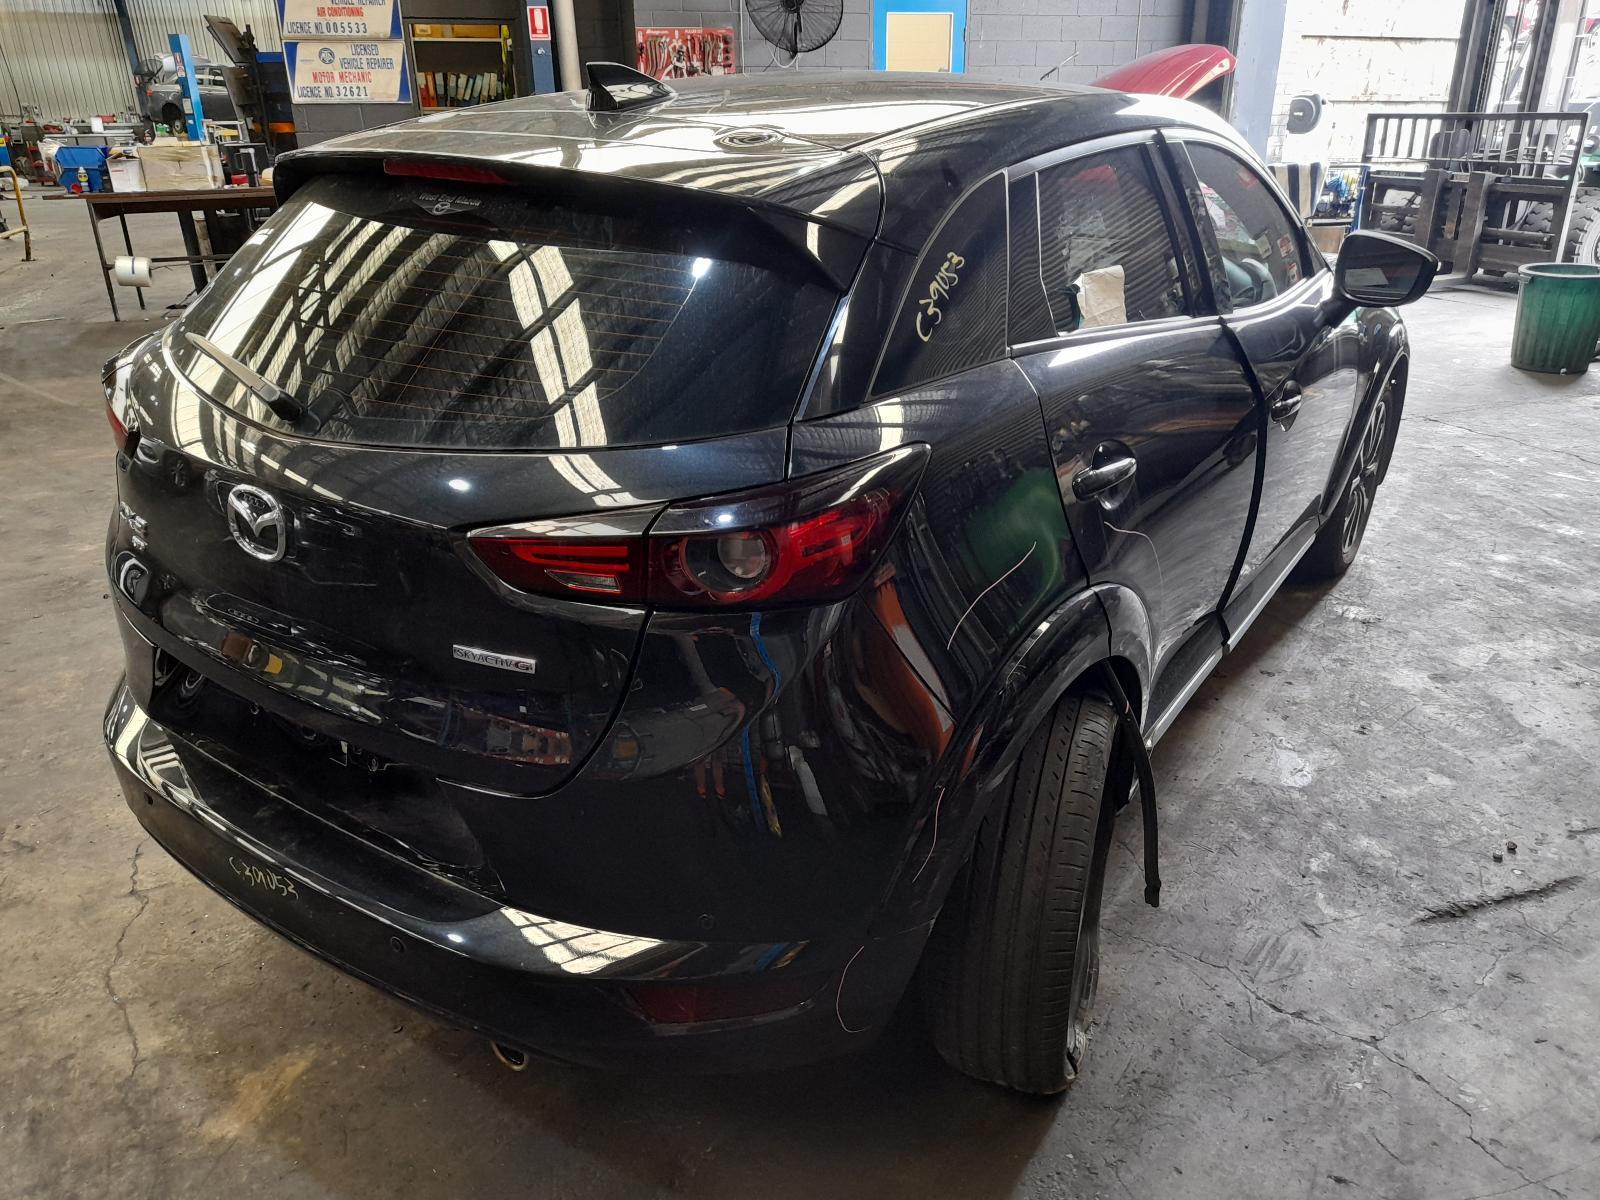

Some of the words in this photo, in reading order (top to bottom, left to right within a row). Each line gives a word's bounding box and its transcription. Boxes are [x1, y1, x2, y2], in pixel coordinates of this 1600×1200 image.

[328, 7, 364, 17] CONDITIONING
[286, 22, 312, 34] LICENCE
[326, 22, 368, 34] 005533
[351, 44, 379, 56] LICENSED
[339, 57, 364, 70] VEHICLE
[366, 57, 395, 70] REPAIRER
[312, 71, 336, 83] MOTOR
[338, 71, 373, 83] MECHANIC
[297, 86, 322, 98] LICENCE
[335, 86, 368, 97] 32621
[916, 251, 965, 342] C39053
